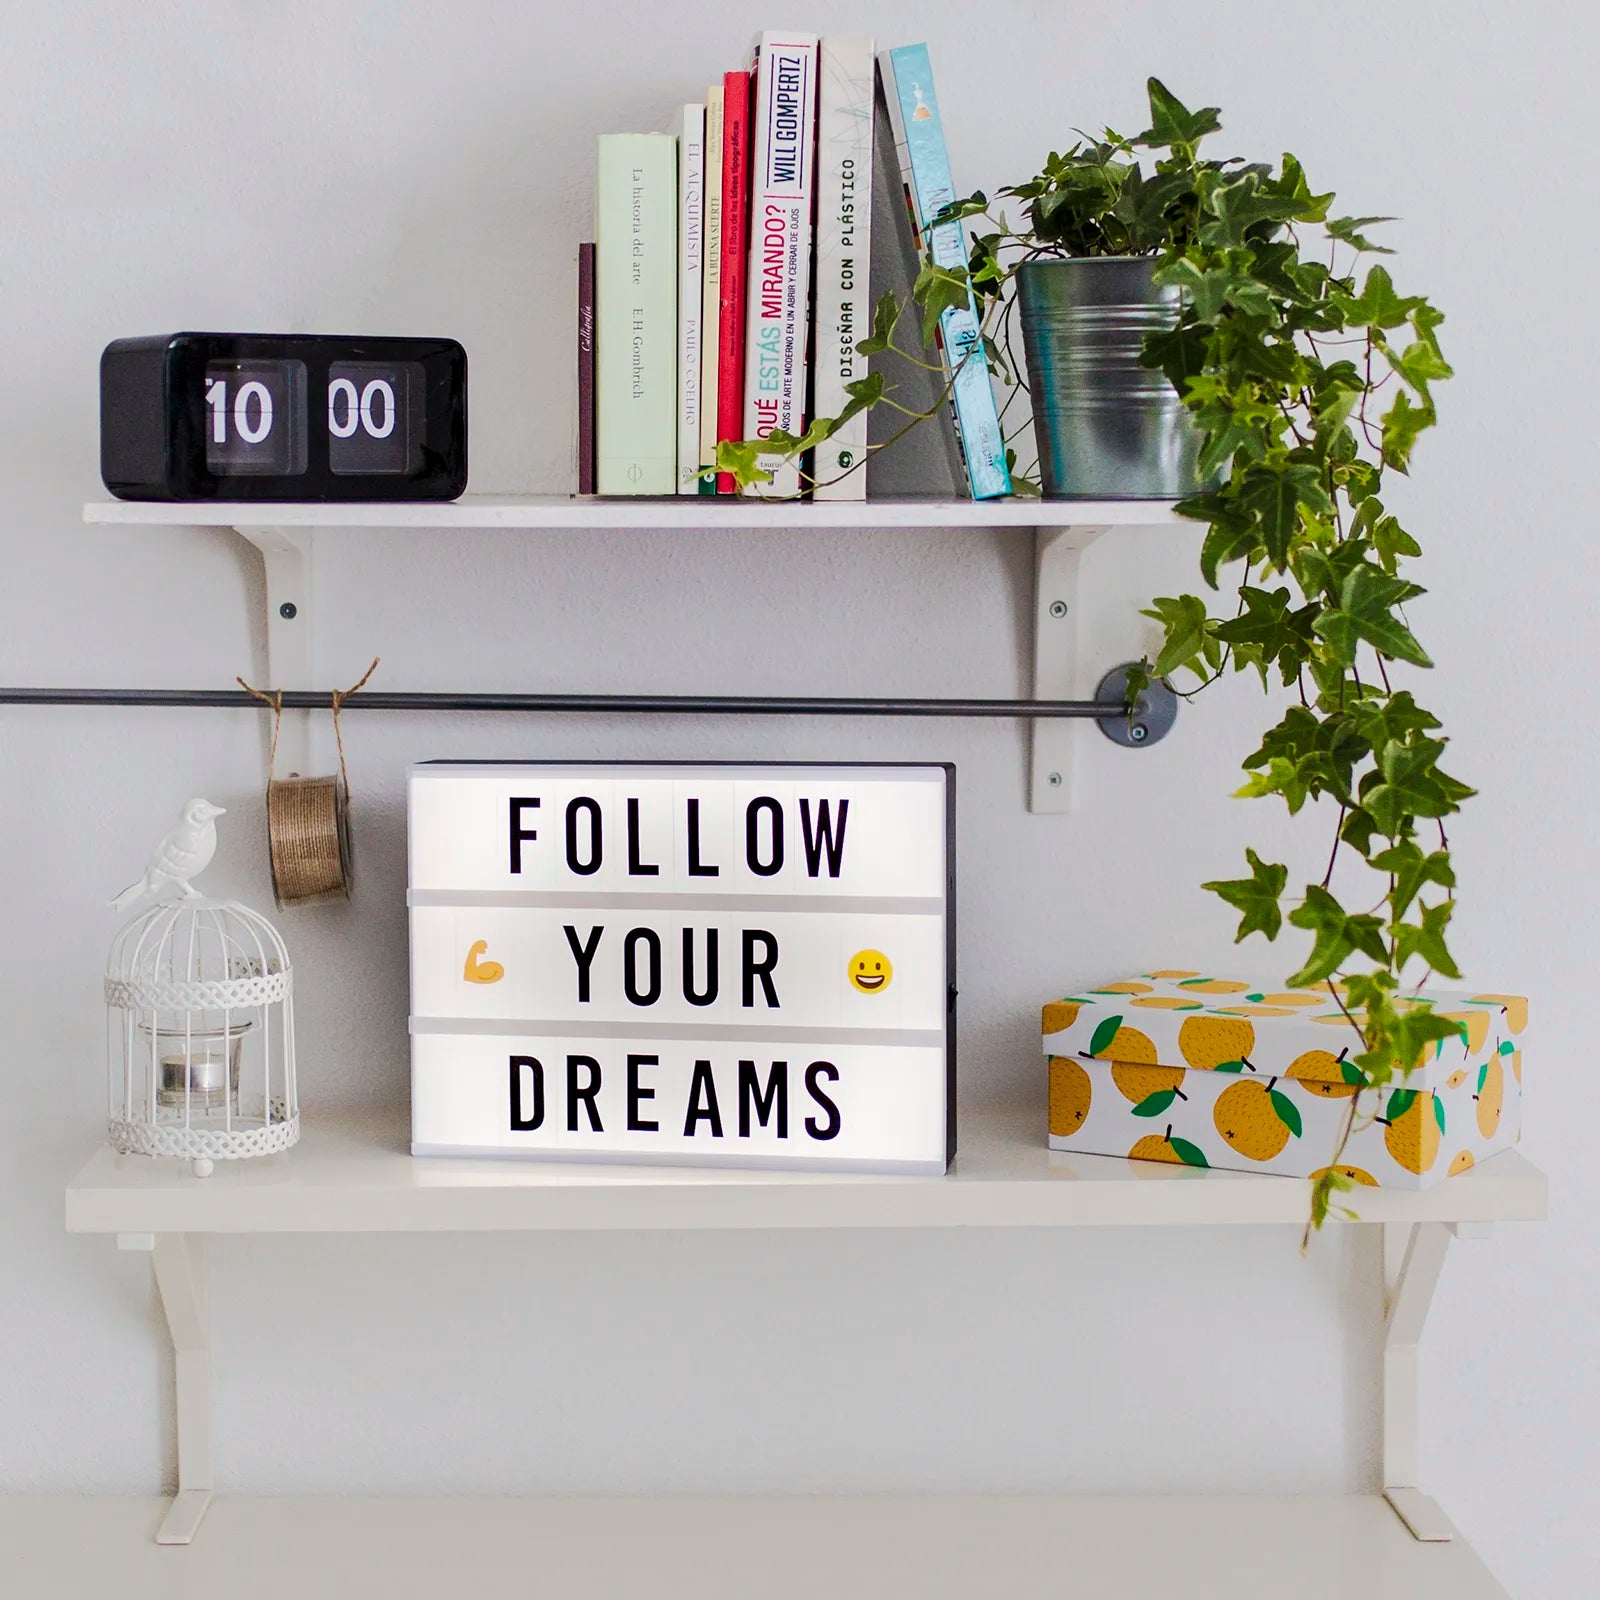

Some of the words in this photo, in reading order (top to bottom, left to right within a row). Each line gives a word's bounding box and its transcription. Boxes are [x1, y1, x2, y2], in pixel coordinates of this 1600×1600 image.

[776, 57, 800, 142] GOMPERTZ
[688, 143, 699, 161] EL
[731, 120, 740, 174] tipográficas
[774, 146, 797, 183] WILL
[632, 168, 643, 182] La
[730, 175, 738, 199] ideas
[632, 187, 644, 234] historia
[685, 169, 699, 271] ALQUIMISTA
[710, 195, 720, 234] SUERTE
[730, 214, 737, 225] de
[790, 208, 799, 230] OJOS
[837, 159, 854, 246] PLÁSTICO
[632, 239, 644, 257] del
[709, 236, 719, 269] BUENA
[790, 232, 798, 242] DE
[632, 262, 642, 286] arte
[709, 269, 718, 284] LA
[761, 204, 786, 318] MIRANDO?
[788, 245, 797, 276] CERRAR
[840, 258, 854, 290] CON
[787, 285, 796, 308] ABRIR
[786, 310, 795, 321] UN
[786, 323, 794, 334] EN
[686, 320, 696, 363] PAULO
[785, 336, 793, 376] MODERNO
[837, 302, 853, 377] DISEÑAR
[759, 327, 781, 391] ESTÁS
[686, 369, 695, 426] COELHO
[783, 378, 792, 398] ARTE
[783, 400, 791, 410] DE
[205, 380, 273, 444] 10
[328, 378, 395, 438] 00
[509, 796, 850, 879] FOLLOW
[563, 925, 781, 1008] YOUR
[509, 1054, 841, 1141] DREAMS
